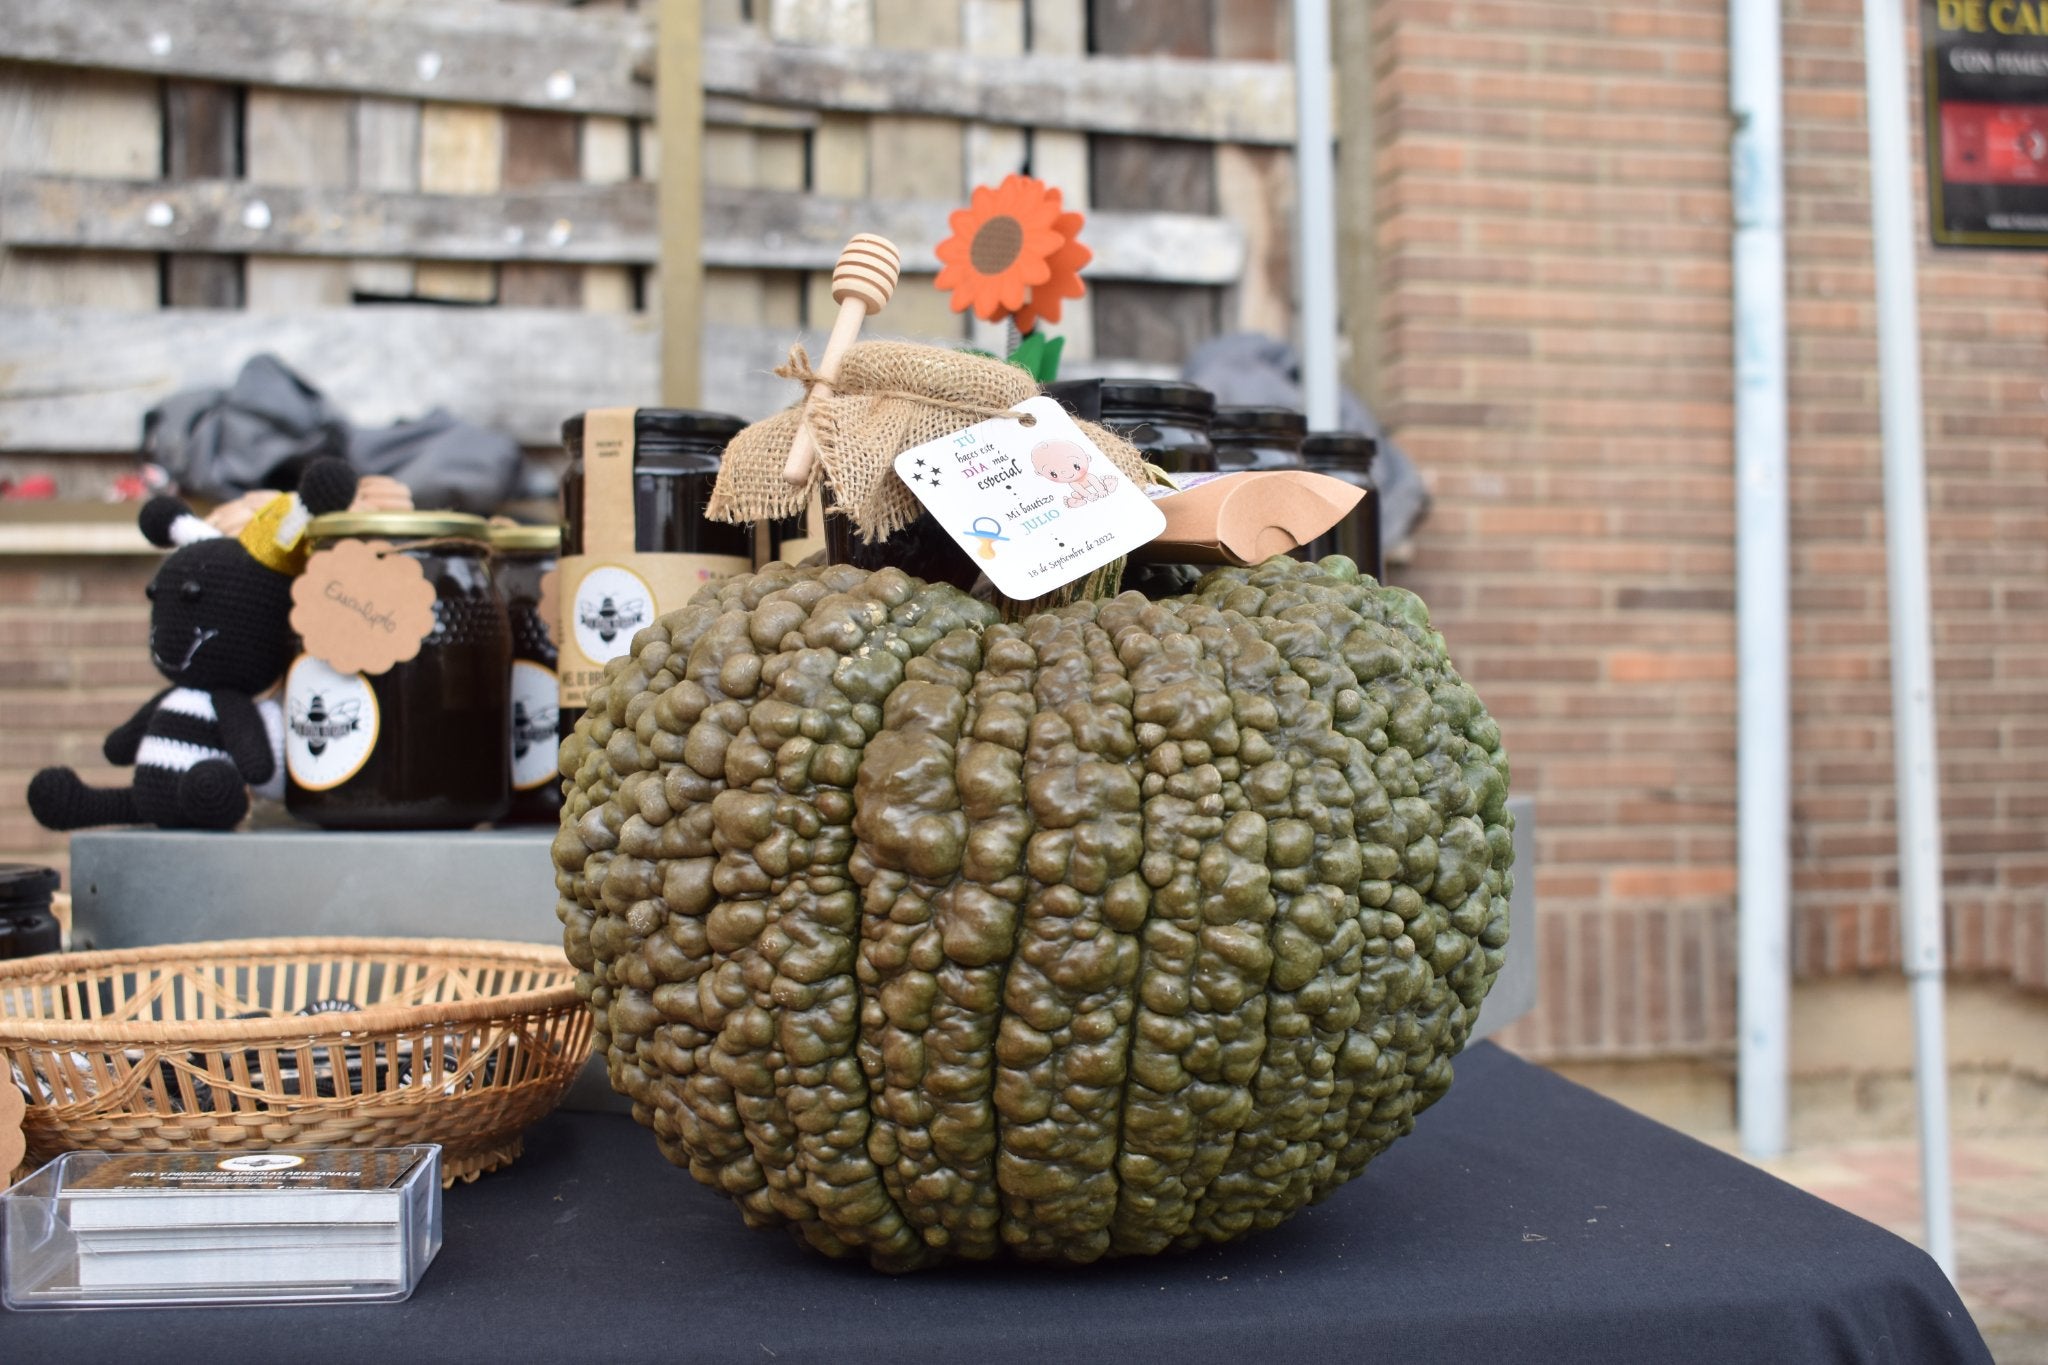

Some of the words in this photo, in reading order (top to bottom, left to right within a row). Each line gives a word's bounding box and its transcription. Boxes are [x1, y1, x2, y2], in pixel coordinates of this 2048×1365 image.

[1937, 0, 1986, 32] DE
[953, 429, 976, 447] TÚ
[955, 450, 978, 464] haces
[980, 443, 995, 454] este
[961, 461, 989, 478] DÍA
[992, 450, 1009, 465] más
[977, 458, 1023, 490] especial
[1005, 508, 1020, 520] Mi
[1019, 494, 1054, 513] bautizo
[1020, 509, 1060, 535] JULIO
[1028, 569, 1038, 578] 18
[1040, 562, 1047, 573] de
[1048, 547, 1085, 569] Septiembre
[1085, 540, 1094, 551] de
[1094, 532, 1115, 546] 2022
